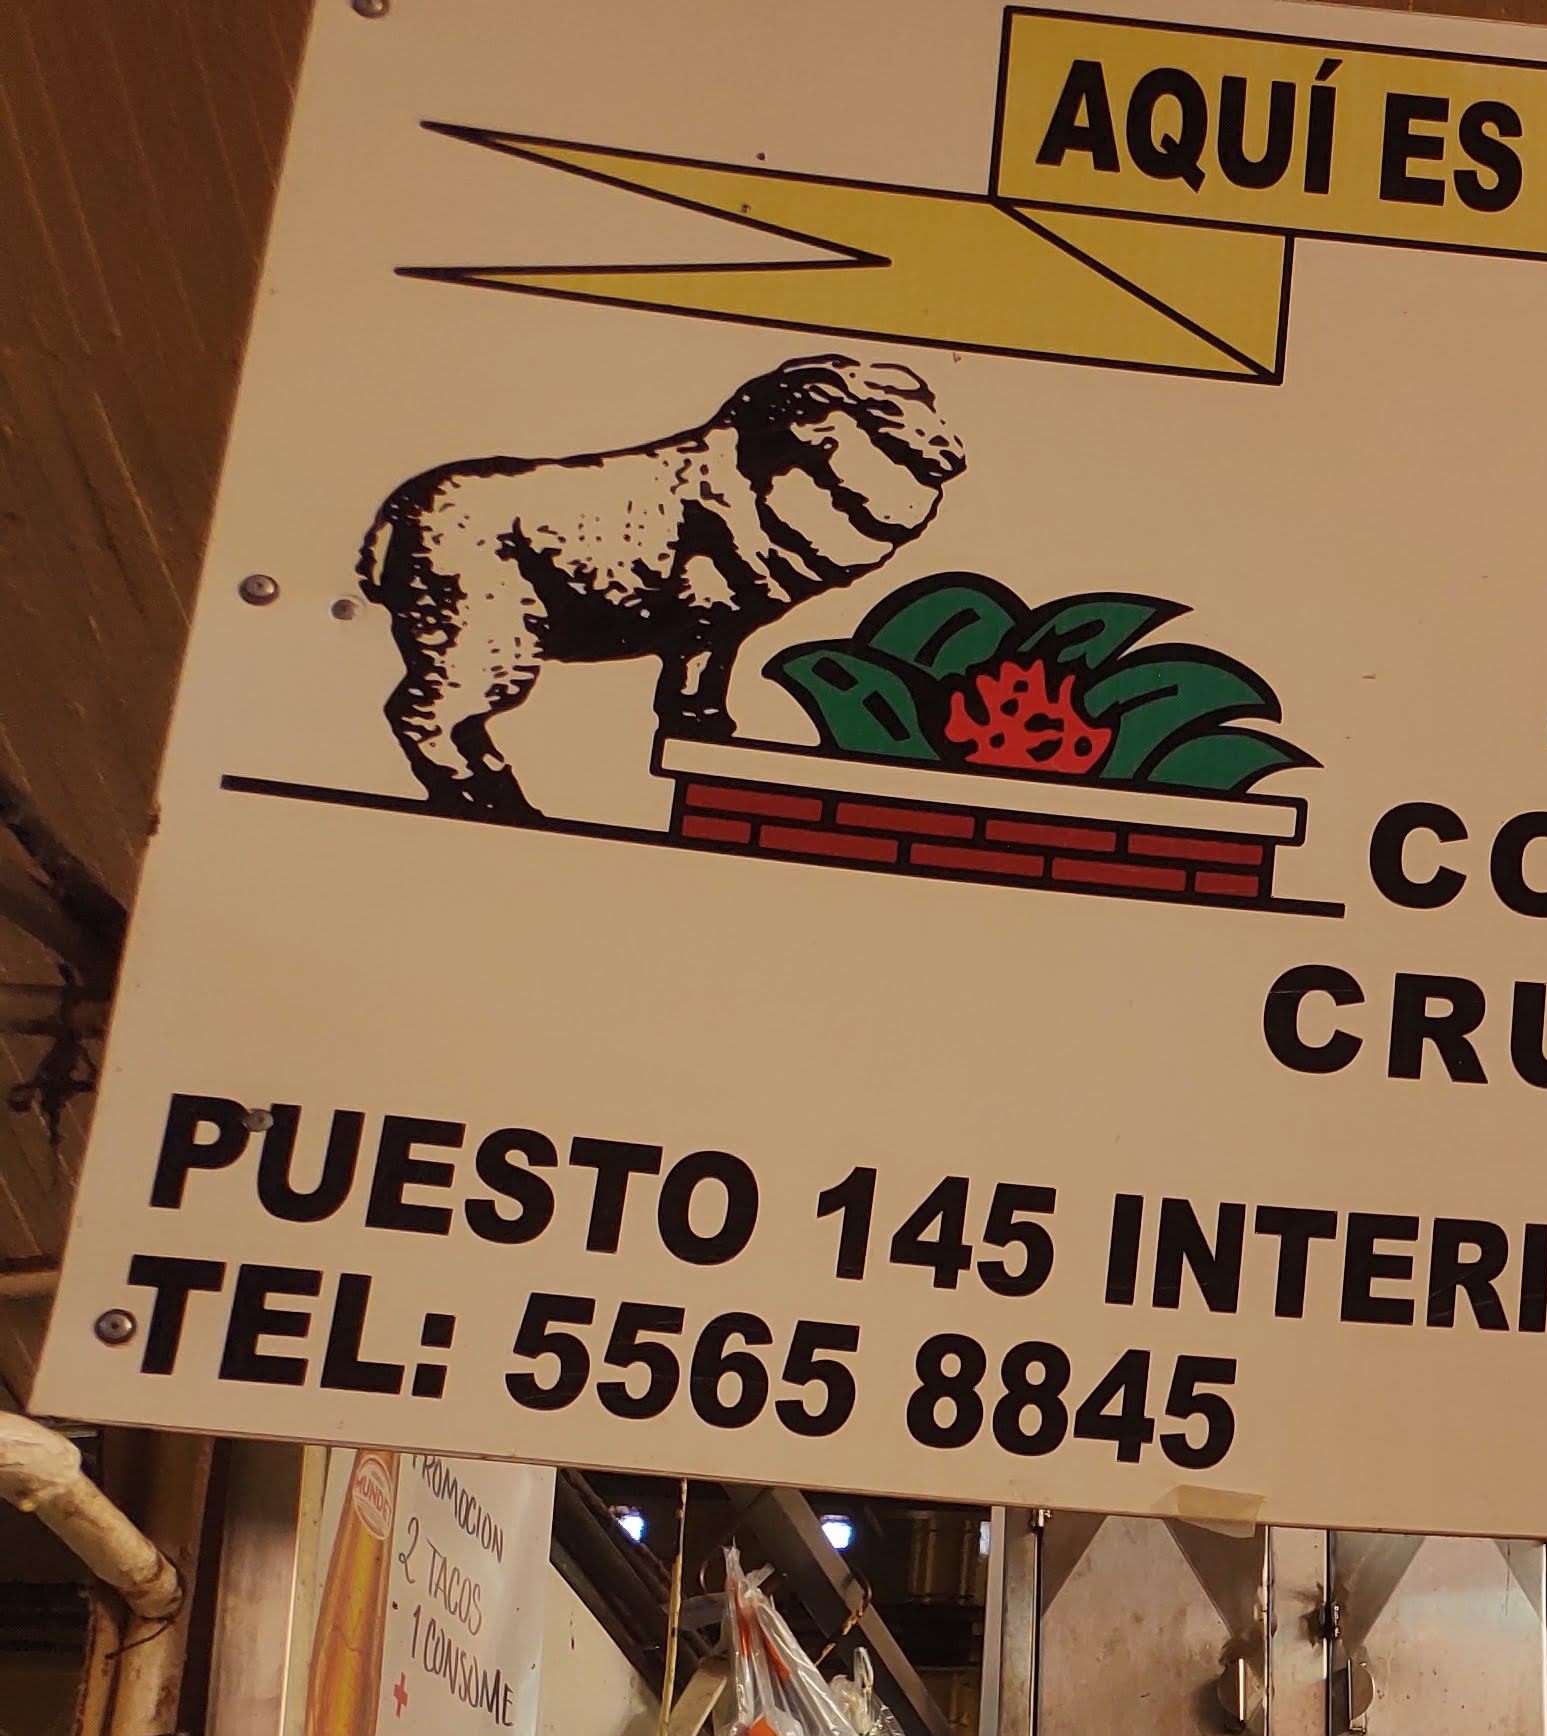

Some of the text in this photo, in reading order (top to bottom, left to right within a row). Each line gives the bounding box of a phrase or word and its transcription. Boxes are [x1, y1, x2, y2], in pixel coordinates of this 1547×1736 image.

[1035, 58, 1343, 195] AQUÍ
[1379, 92, 1523, 212] ES
[149, 1093, 759, 1266] PUESTO
[817, 1166, 1057, 1297] 145
[126, 1254, 1238, 1470] TEL: 5565 8845
[398, 1517, 483, 1637] 2 TACOS
[411, 1604, 515, 1728] 1 CONSOME
